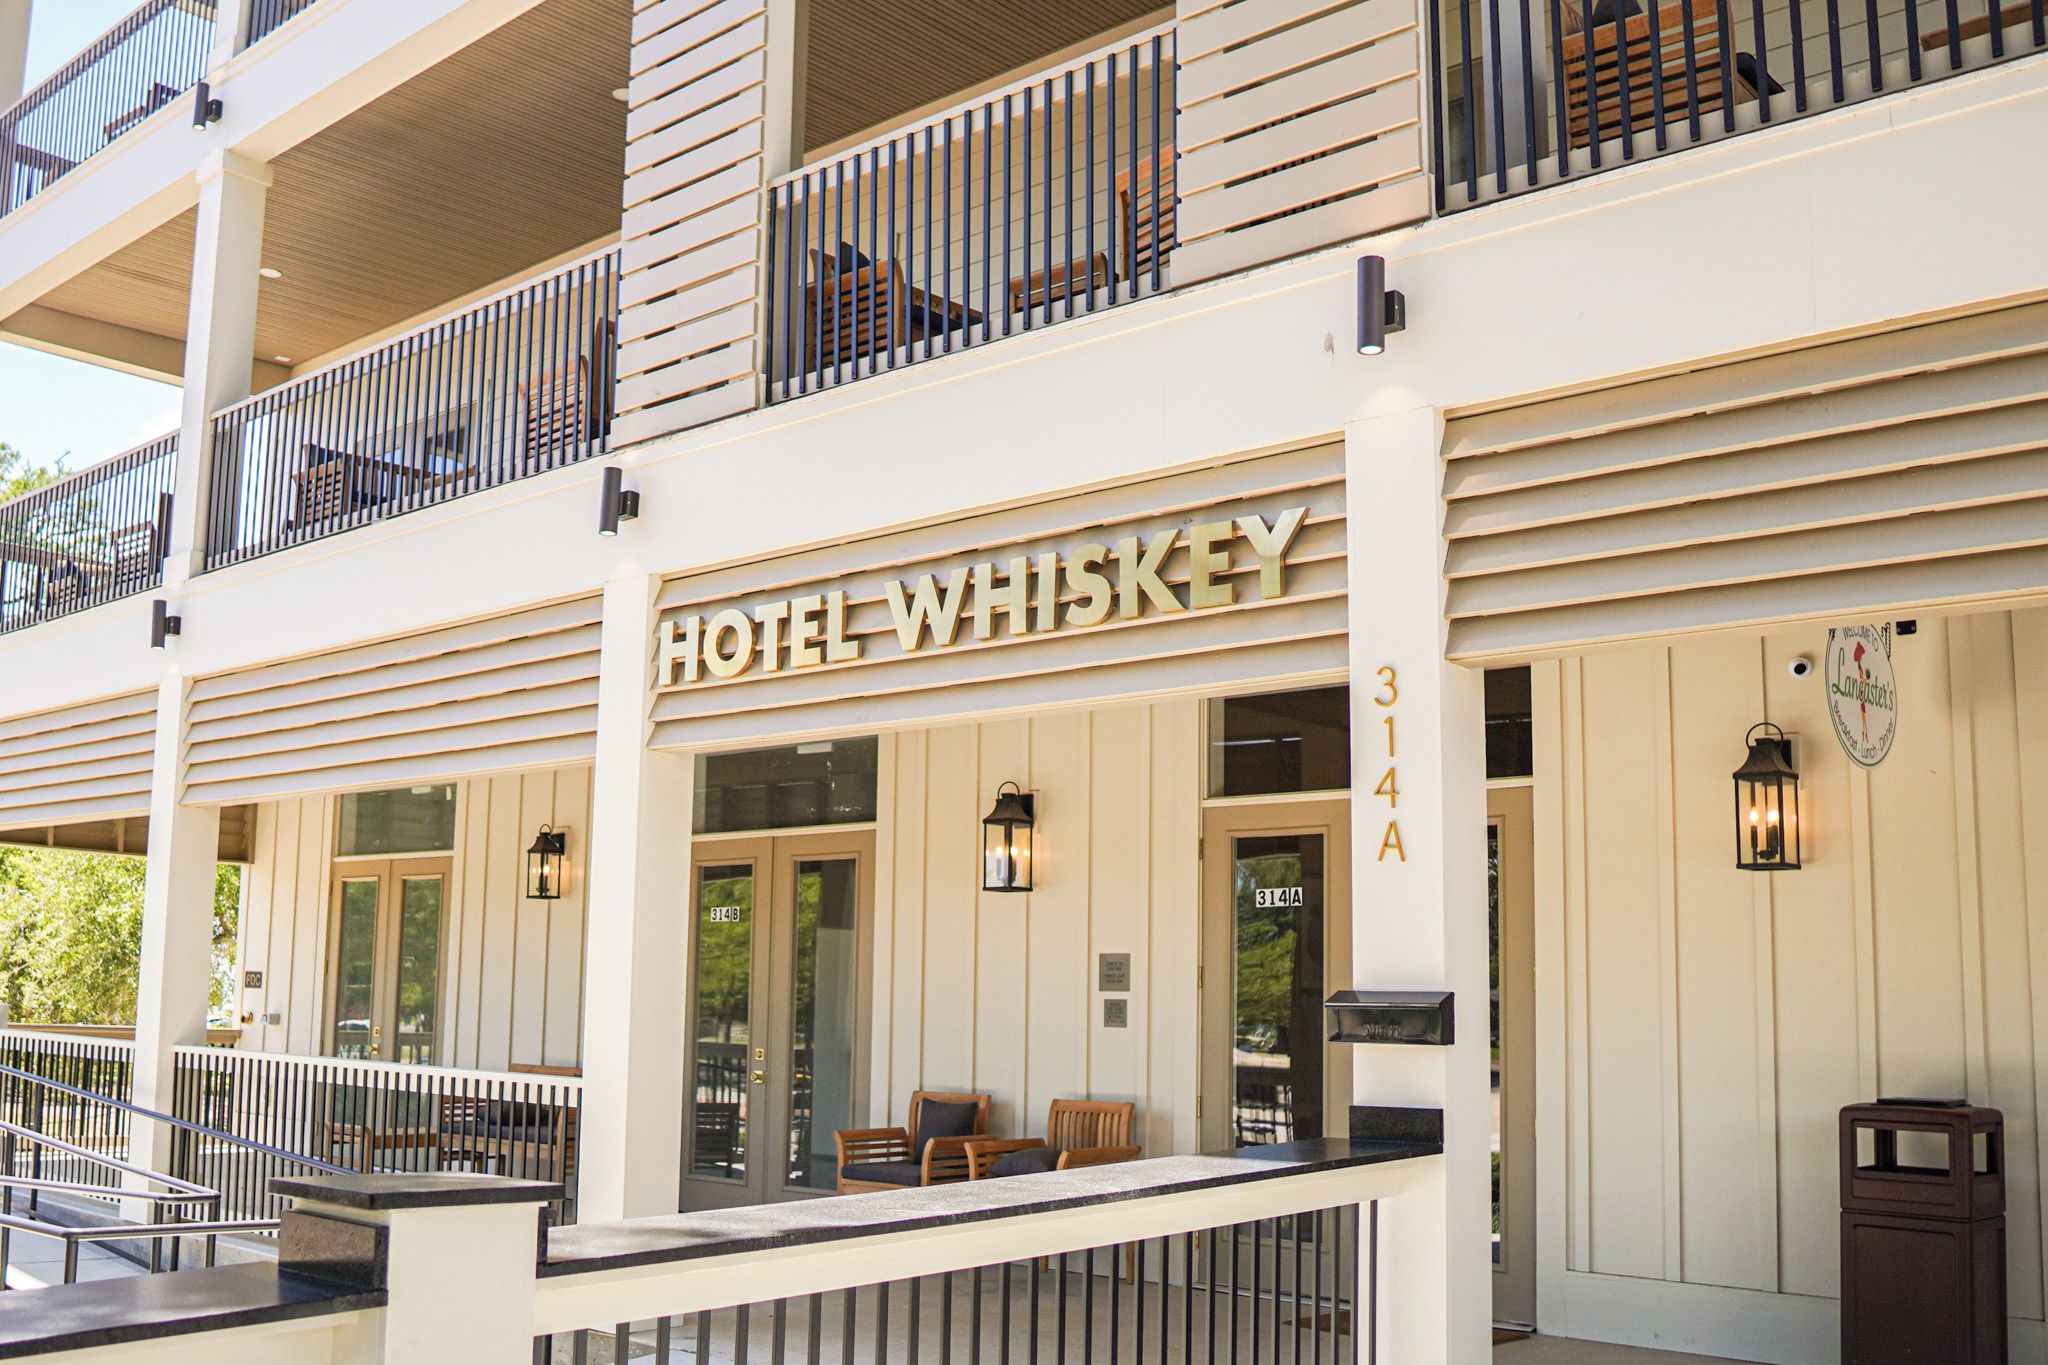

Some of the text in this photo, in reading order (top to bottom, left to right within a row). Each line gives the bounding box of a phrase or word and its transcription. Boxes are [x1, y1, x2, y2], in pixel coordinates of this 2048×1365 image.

[658, 506, 1310, 686] HOTEL WHISKEY
[1871, 633, 1879, 652] TO
[1832, 647, 1894, 711] Lancaster's
[1833, 699, 1894, 759] Breakfast Lunch Dinner
